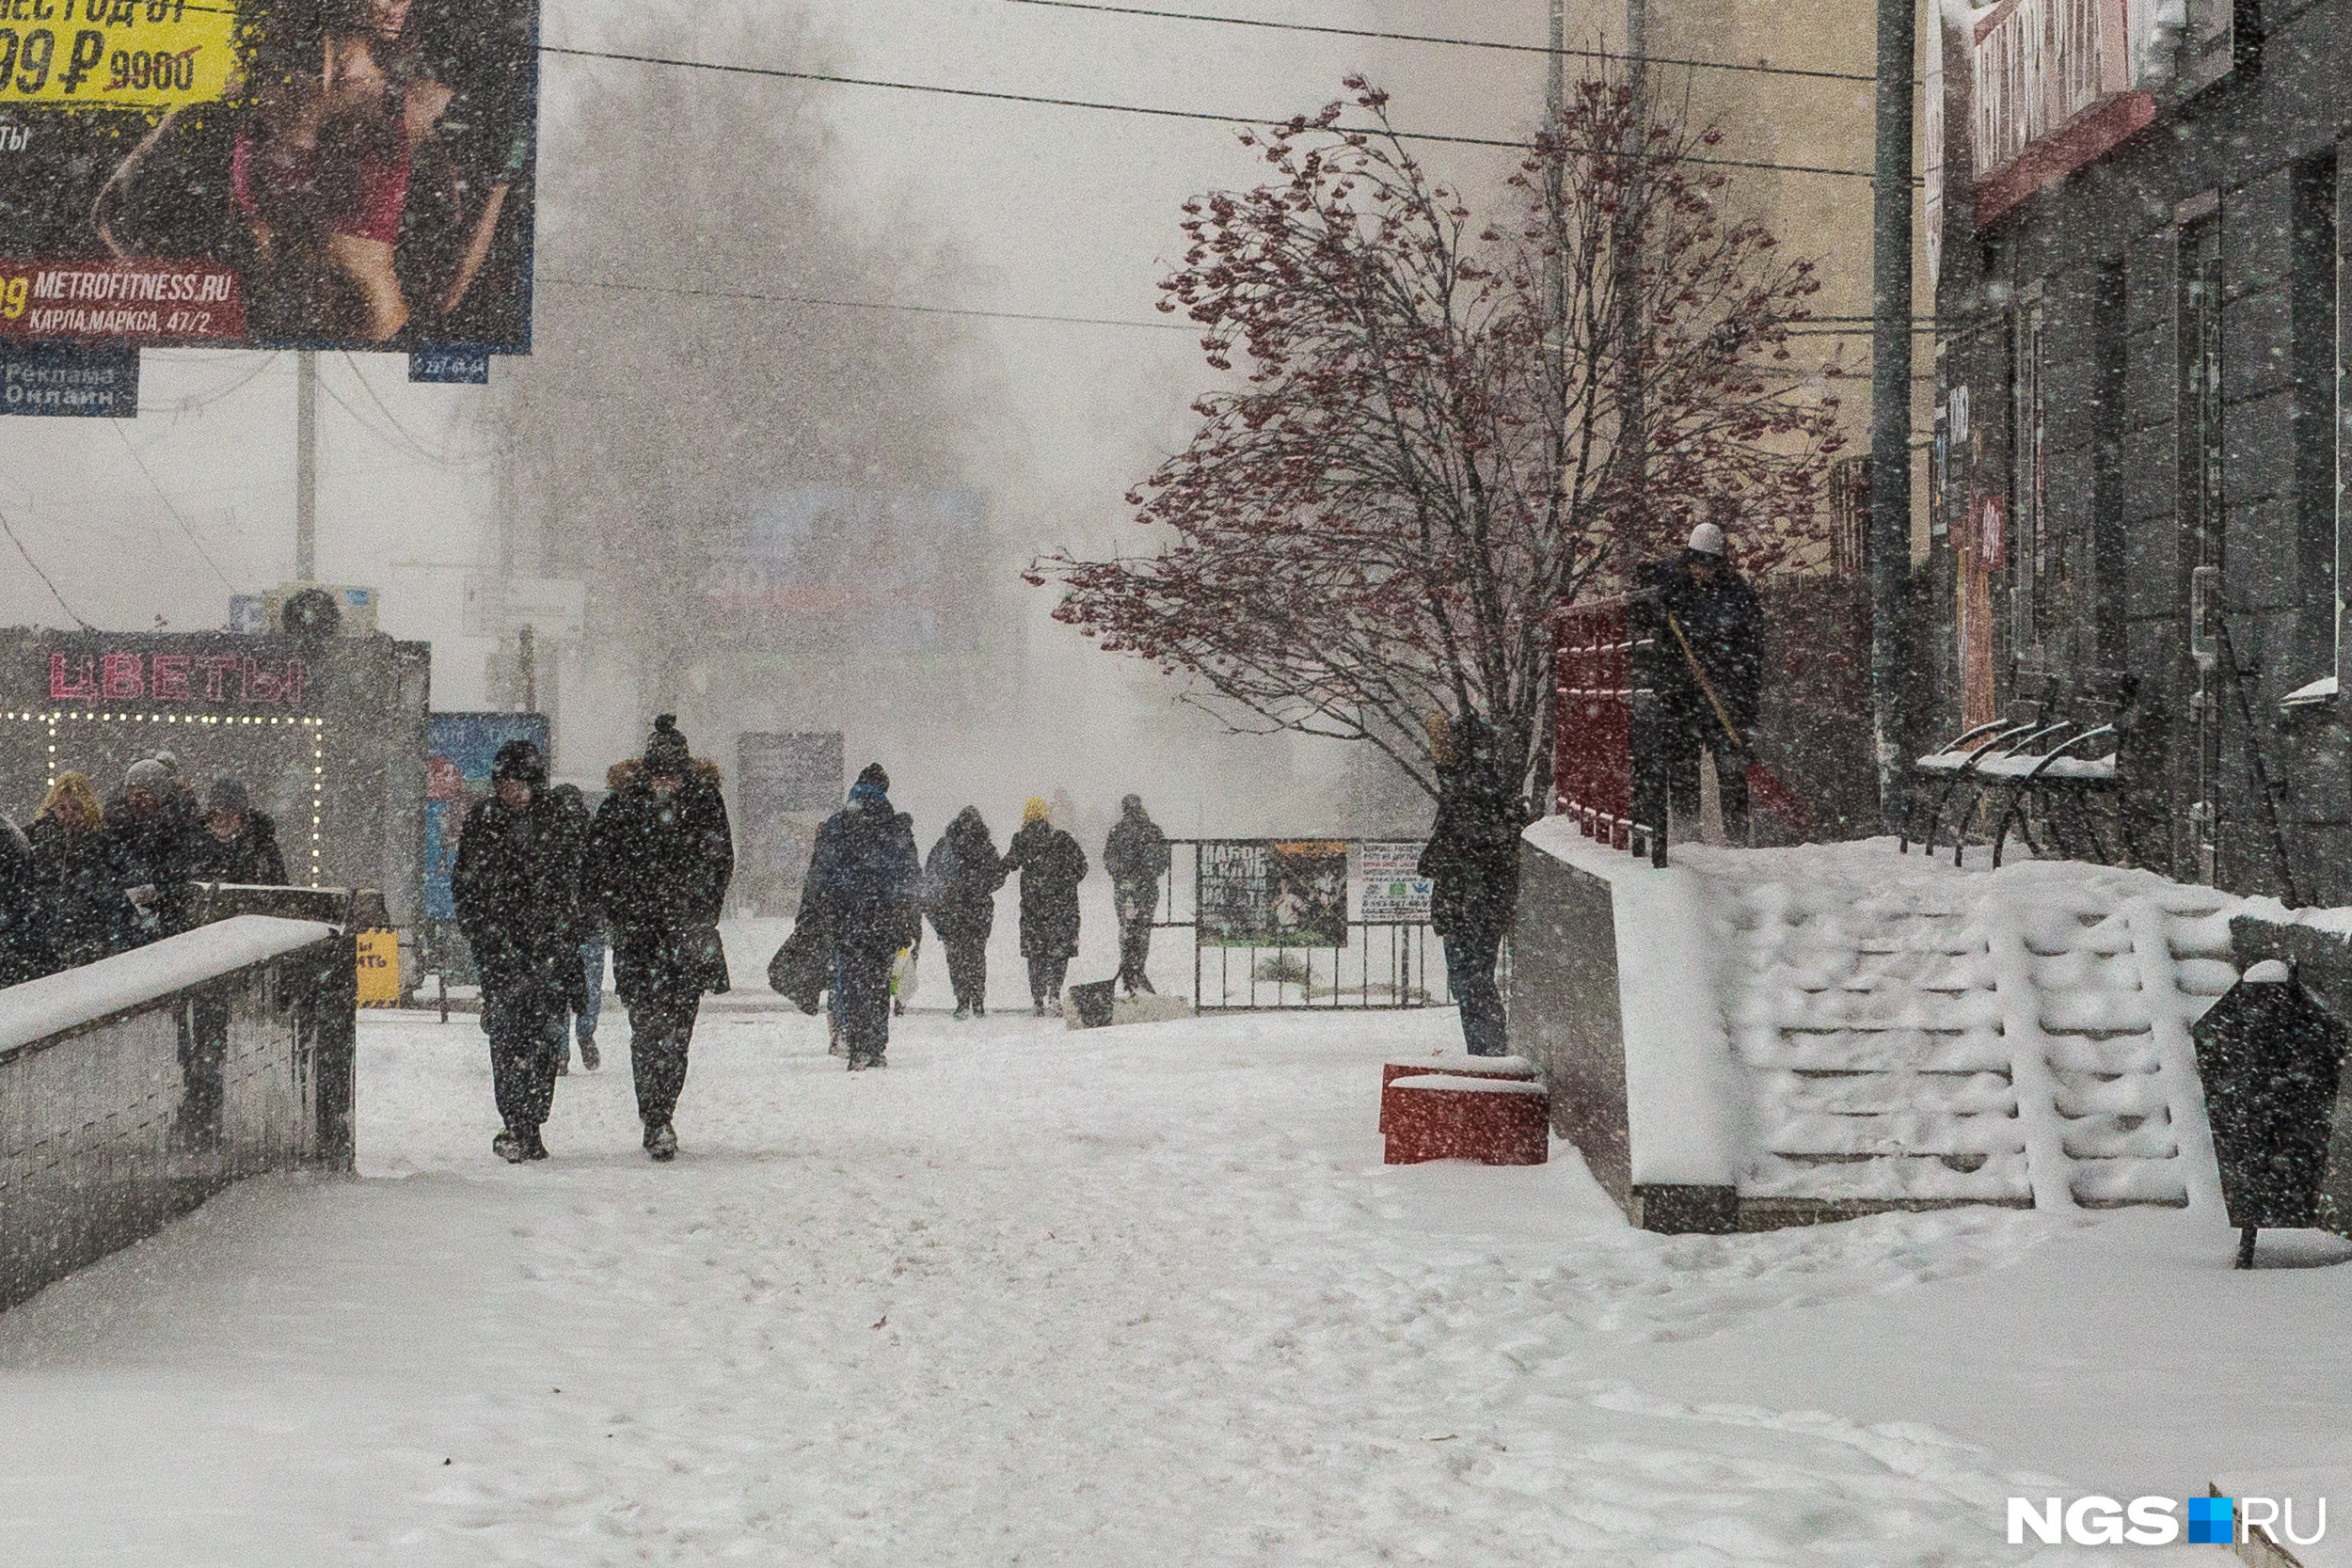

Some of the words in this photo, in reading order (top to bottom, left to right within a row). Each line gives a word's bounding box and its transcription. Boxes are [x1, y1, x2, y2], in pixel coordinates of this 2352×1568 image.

[109, 50, 195, 90] 9900
[34, 271, 232, 301] METROFITNESS.RU
[29, 309, 84, 331] КАРЛА
[167, 310, 212, 333] 47/2
[50, 653, 304, 705] ЦВЕТЫ
